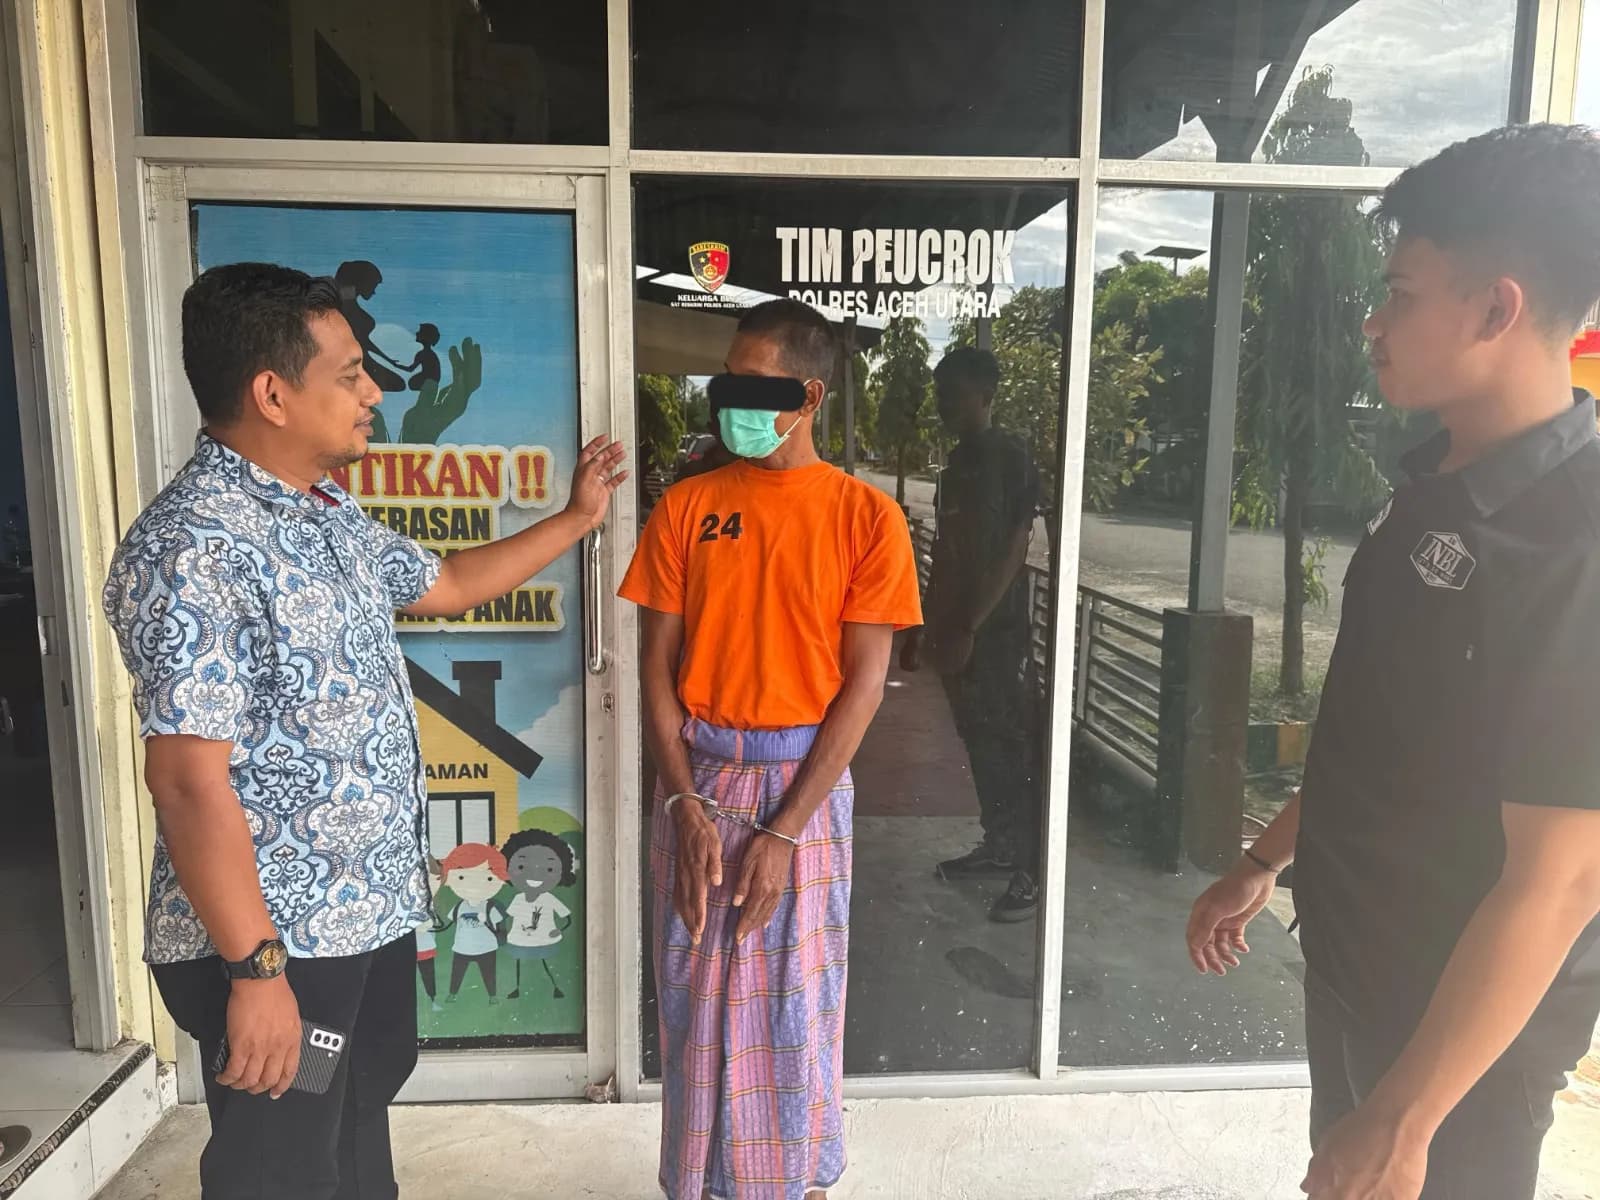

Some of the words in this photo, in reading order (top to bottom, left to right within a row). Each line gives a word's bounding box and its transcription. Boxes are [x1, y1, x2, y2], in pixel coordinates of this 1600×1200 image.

[776, 227, 843, 283] TIM
[852, 228, 1016, 285] PEUCROK
[678, 294, 718, 302] KELUARGA
[874, 290, 928, 318] ACEH
[936, 290, 1001, 318] UTARA
[699, 512, 743, 543] 24
[474, 590, 556, 622] ANAK
